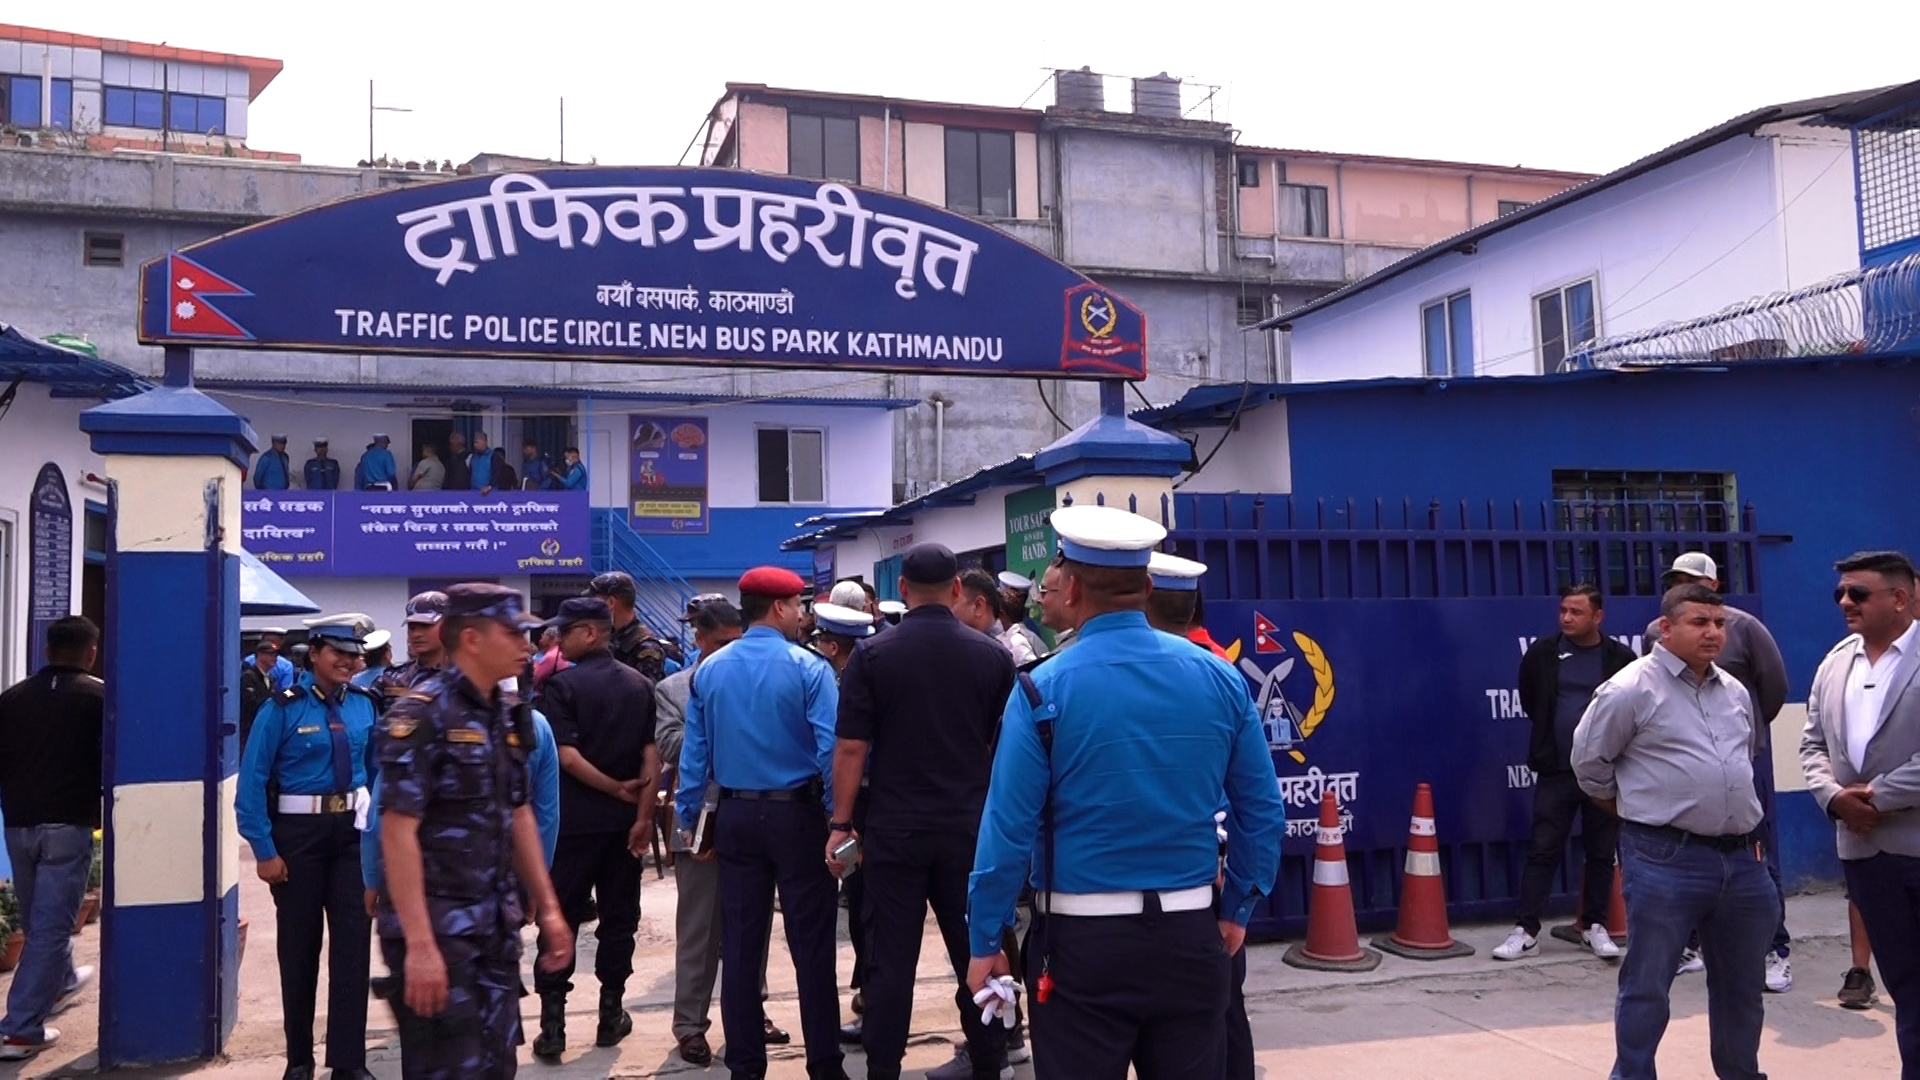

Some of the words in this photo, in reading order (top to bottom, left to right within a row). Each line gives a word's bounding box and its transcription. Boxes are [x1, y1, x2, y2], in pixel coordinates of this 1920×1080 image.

[396, 173, 688, 287] ट्राफिक
[335, 308, 454, 340] TRAFFIC
[464, 314, 559, 344] POLICE
[649, 323, 706, 350] NEW
[716, 326, 766, 352] BUS
[772, 328, 839, 355] PARK
[847, 331, 1003, 362] KATHMANDU
[1022, 541, 1047, 561] HANDS
